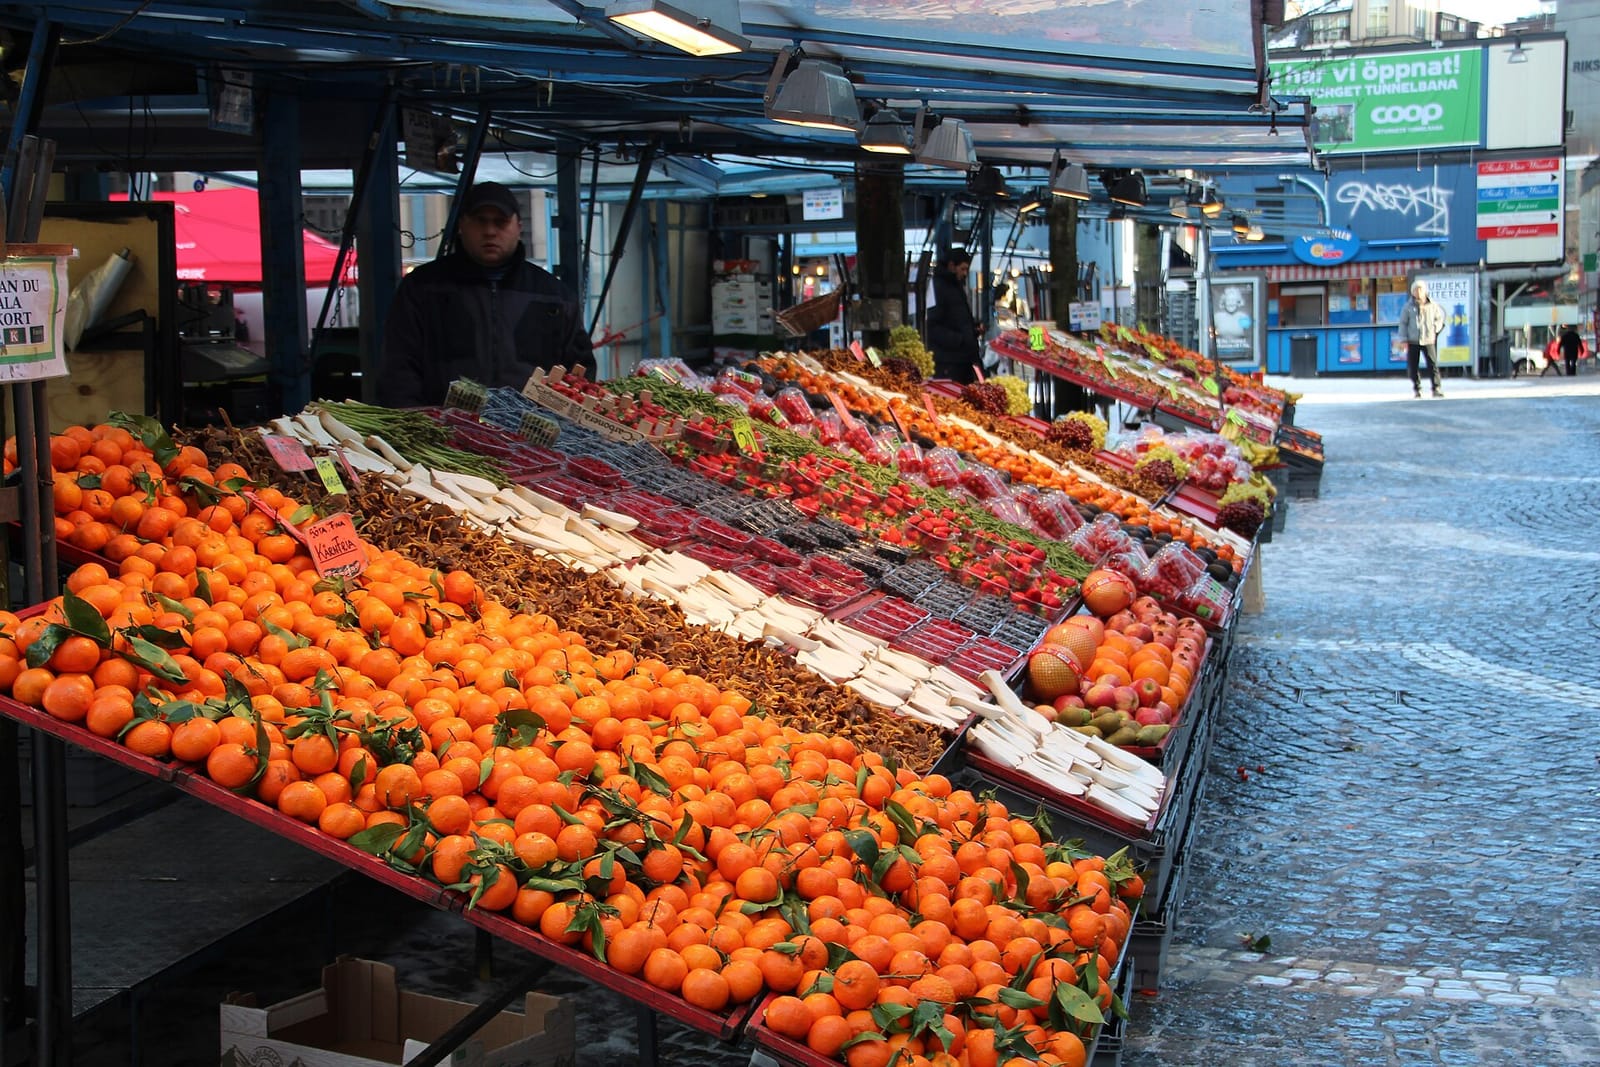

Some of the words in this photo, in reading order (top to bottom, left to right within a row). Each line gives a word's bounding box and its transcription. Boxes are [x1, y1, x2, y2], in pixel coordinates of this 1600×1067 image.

[1286, 65, 1328, 84] har
[1333, 62, 1356, 83] vi
[1362, 53, 1461, 86] öppnat!
[1364, 78, 1458, 96] TUNNELBANA
[1370, 103, 1444, 127] coop
[23, 279, 40, 293] DU
